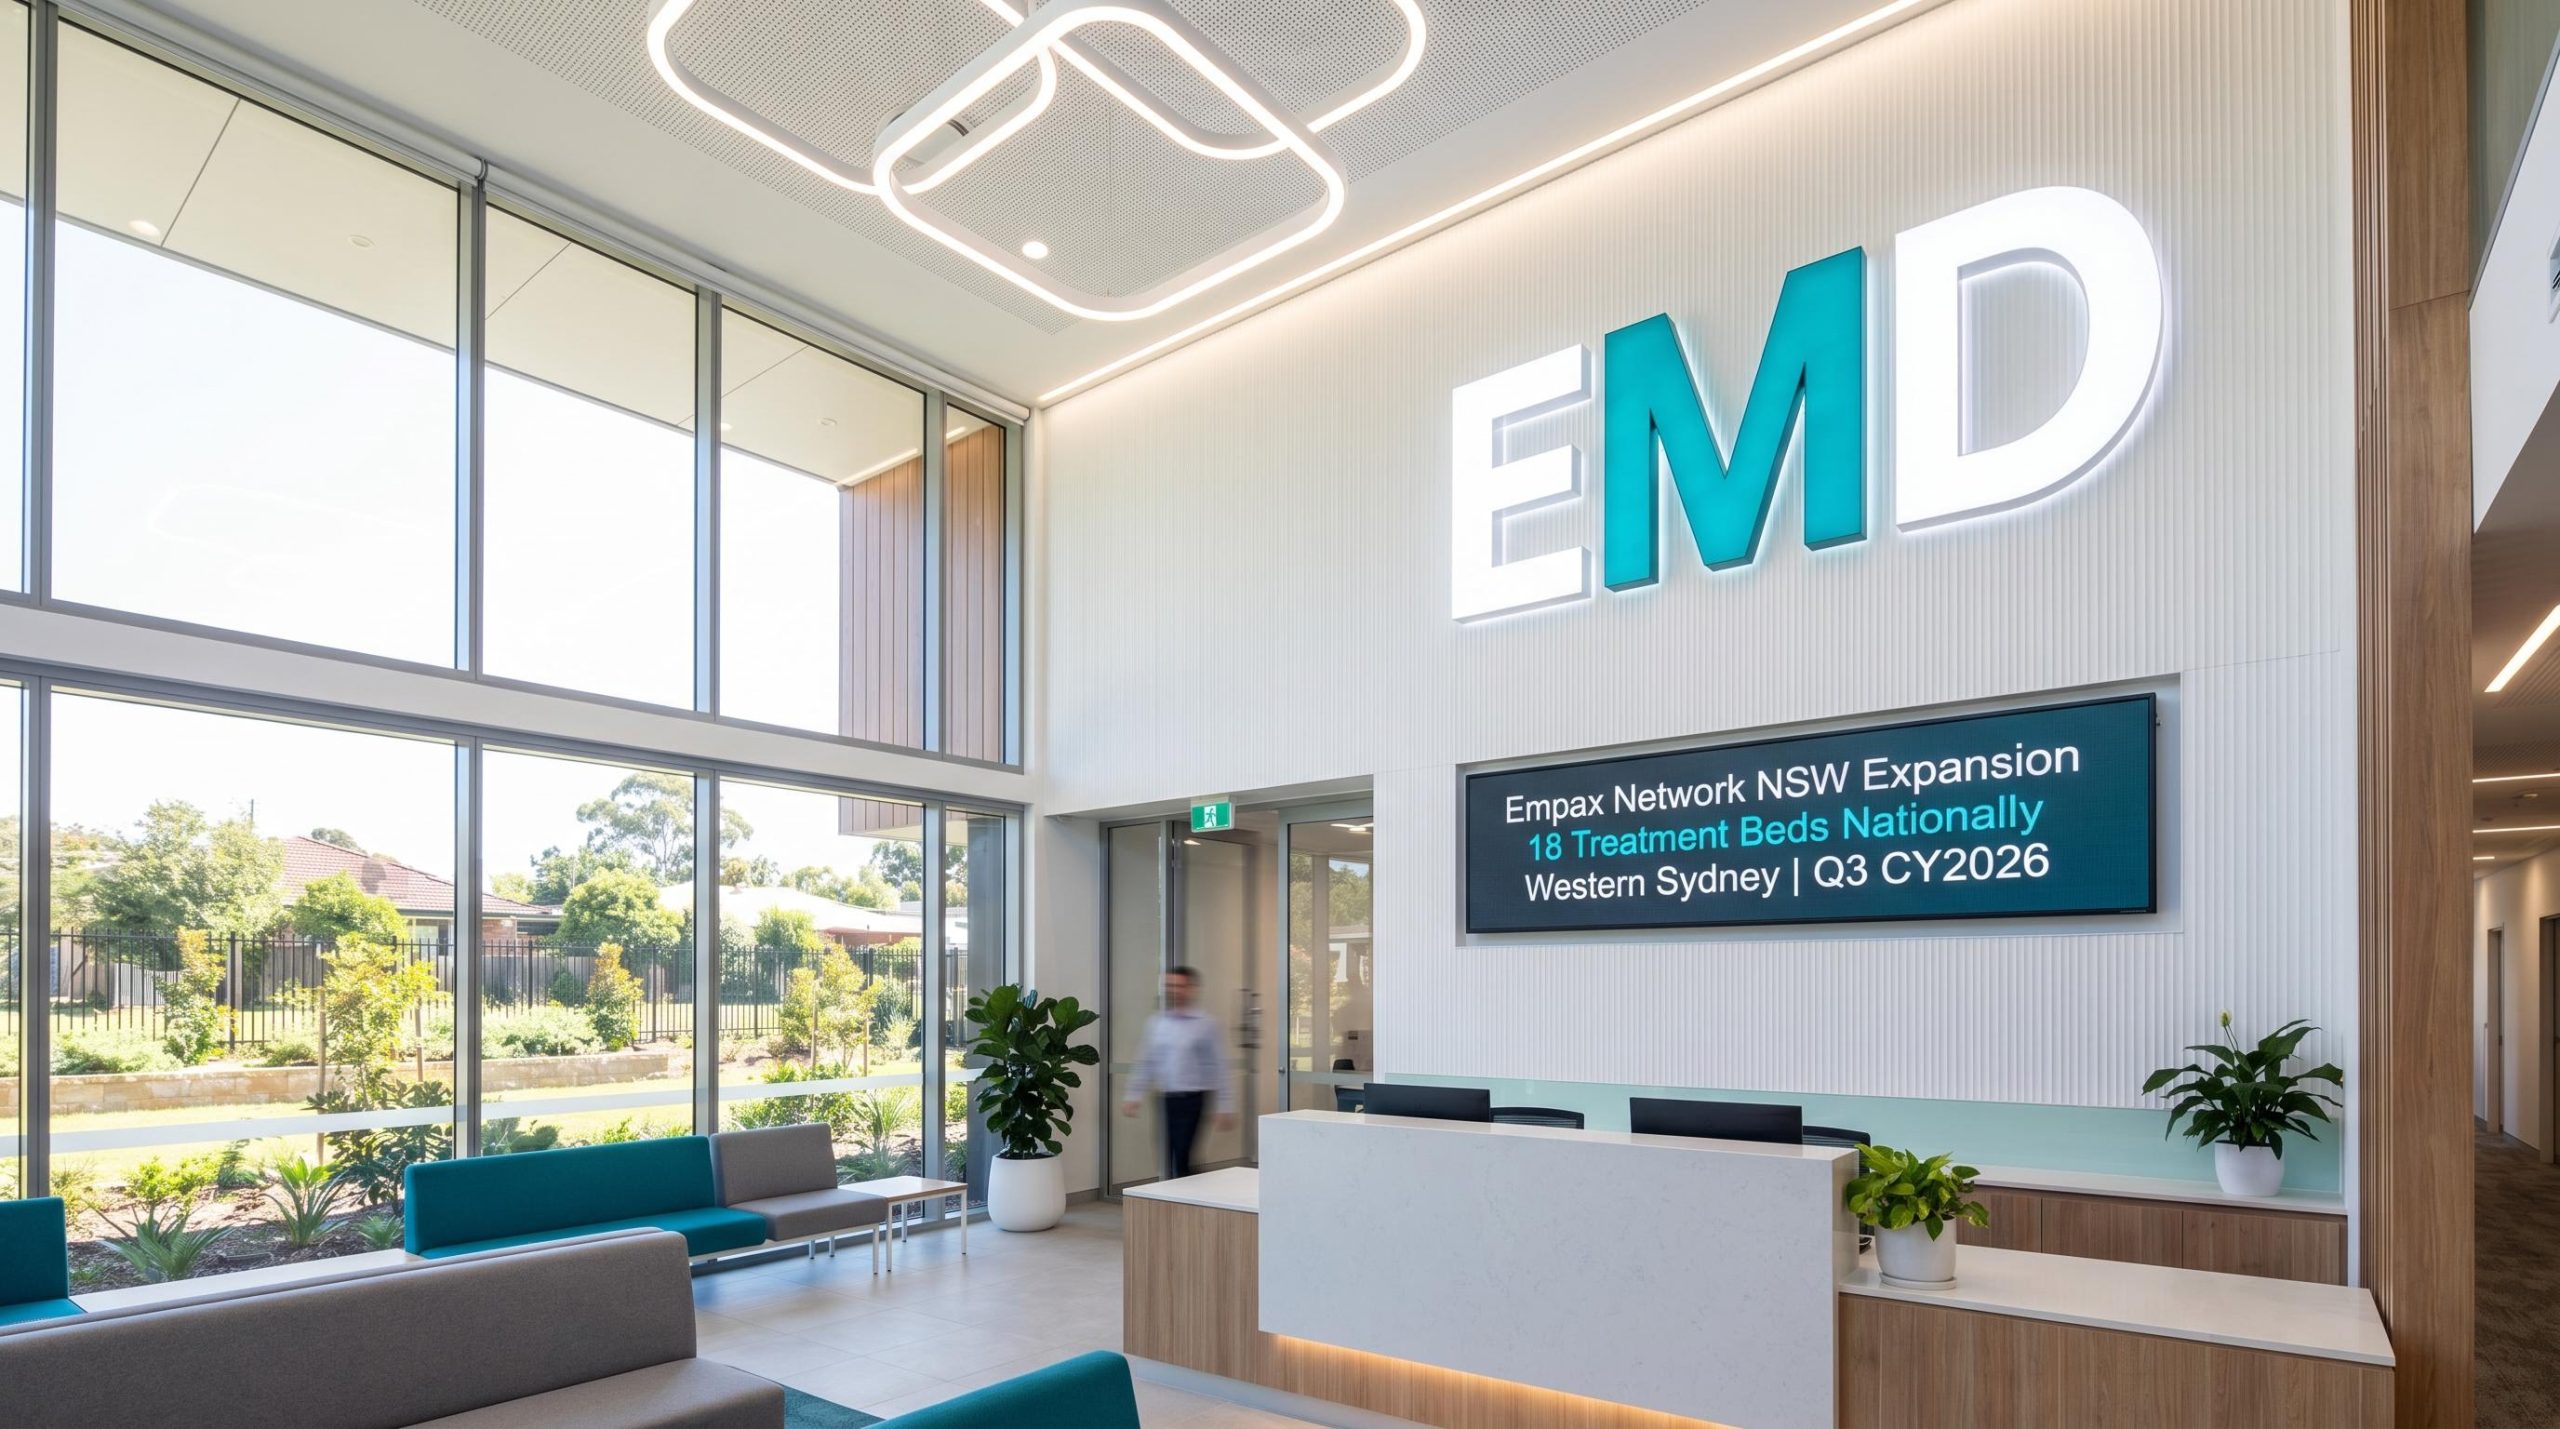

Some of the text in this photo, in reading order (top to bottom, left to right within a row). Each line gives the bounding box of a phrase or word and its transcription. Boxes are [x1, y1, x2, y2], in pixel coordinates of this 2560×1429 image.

[1452, 186, 2164, 624] EMD
[1505, 742, 2080, 827] Empax Network NSW Expansion
[1528, 793, 2045, 861] 18 Treatment Beds Nationally
[1524, 871, 1646, 902] Western
[1656, 862, 1782, 903] Sydney
[1813, 854, 1869, 889] Q3
[1881, 842, 2051, 885] CY2026
